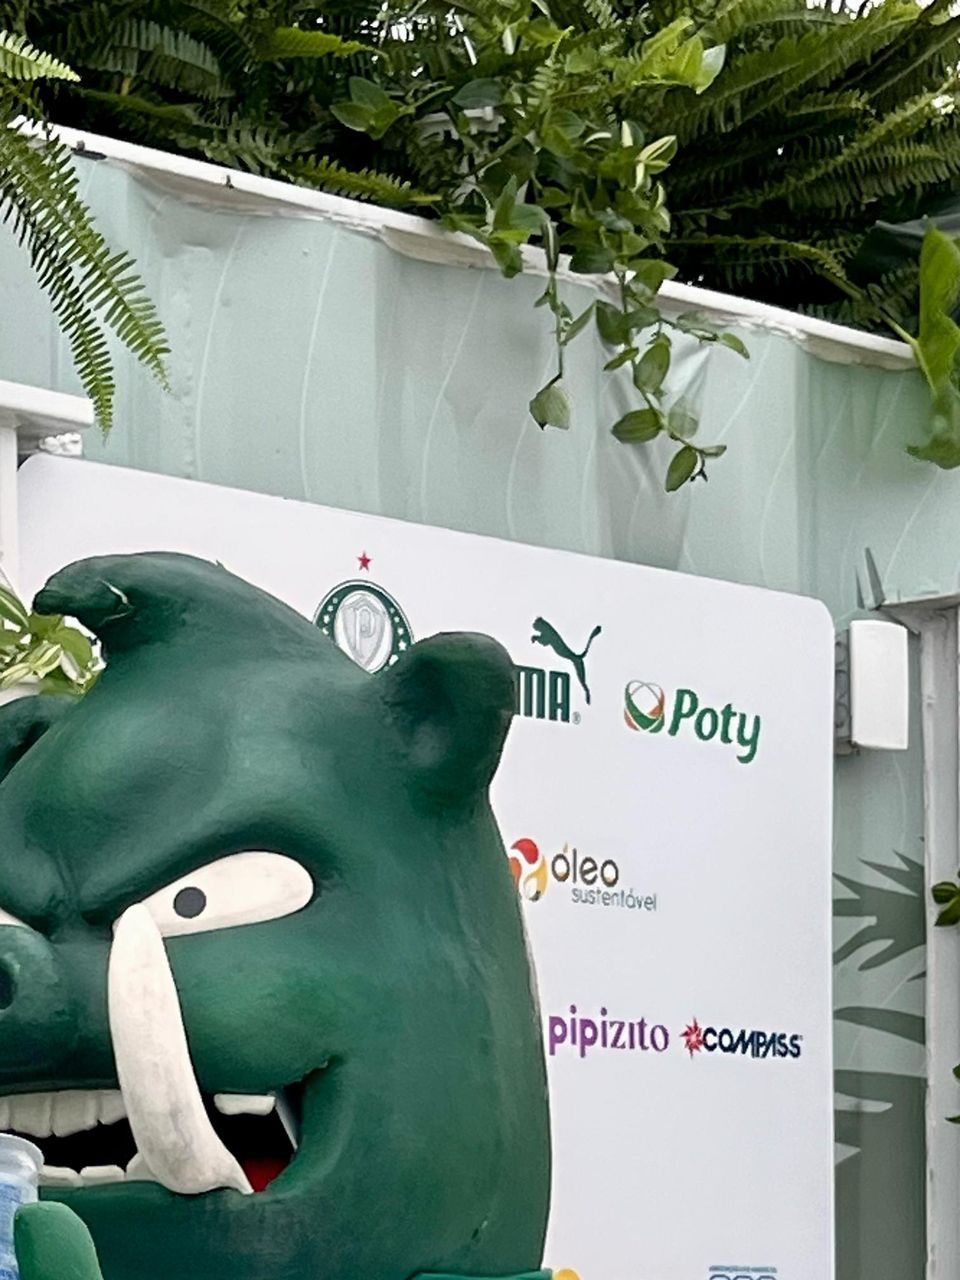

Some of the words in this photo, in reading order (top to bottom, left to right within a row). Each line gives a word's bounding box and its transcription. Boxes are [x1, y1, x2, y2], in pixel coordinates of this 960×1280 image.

[668, 688, 761, 765] Poty
[551, 842, 619, 887] óleo
[571, 887, 657, 912] sustentável
[549, 1004, 670, 1058] pipizito
[702, 1026, 802, 1059] COMPASS
